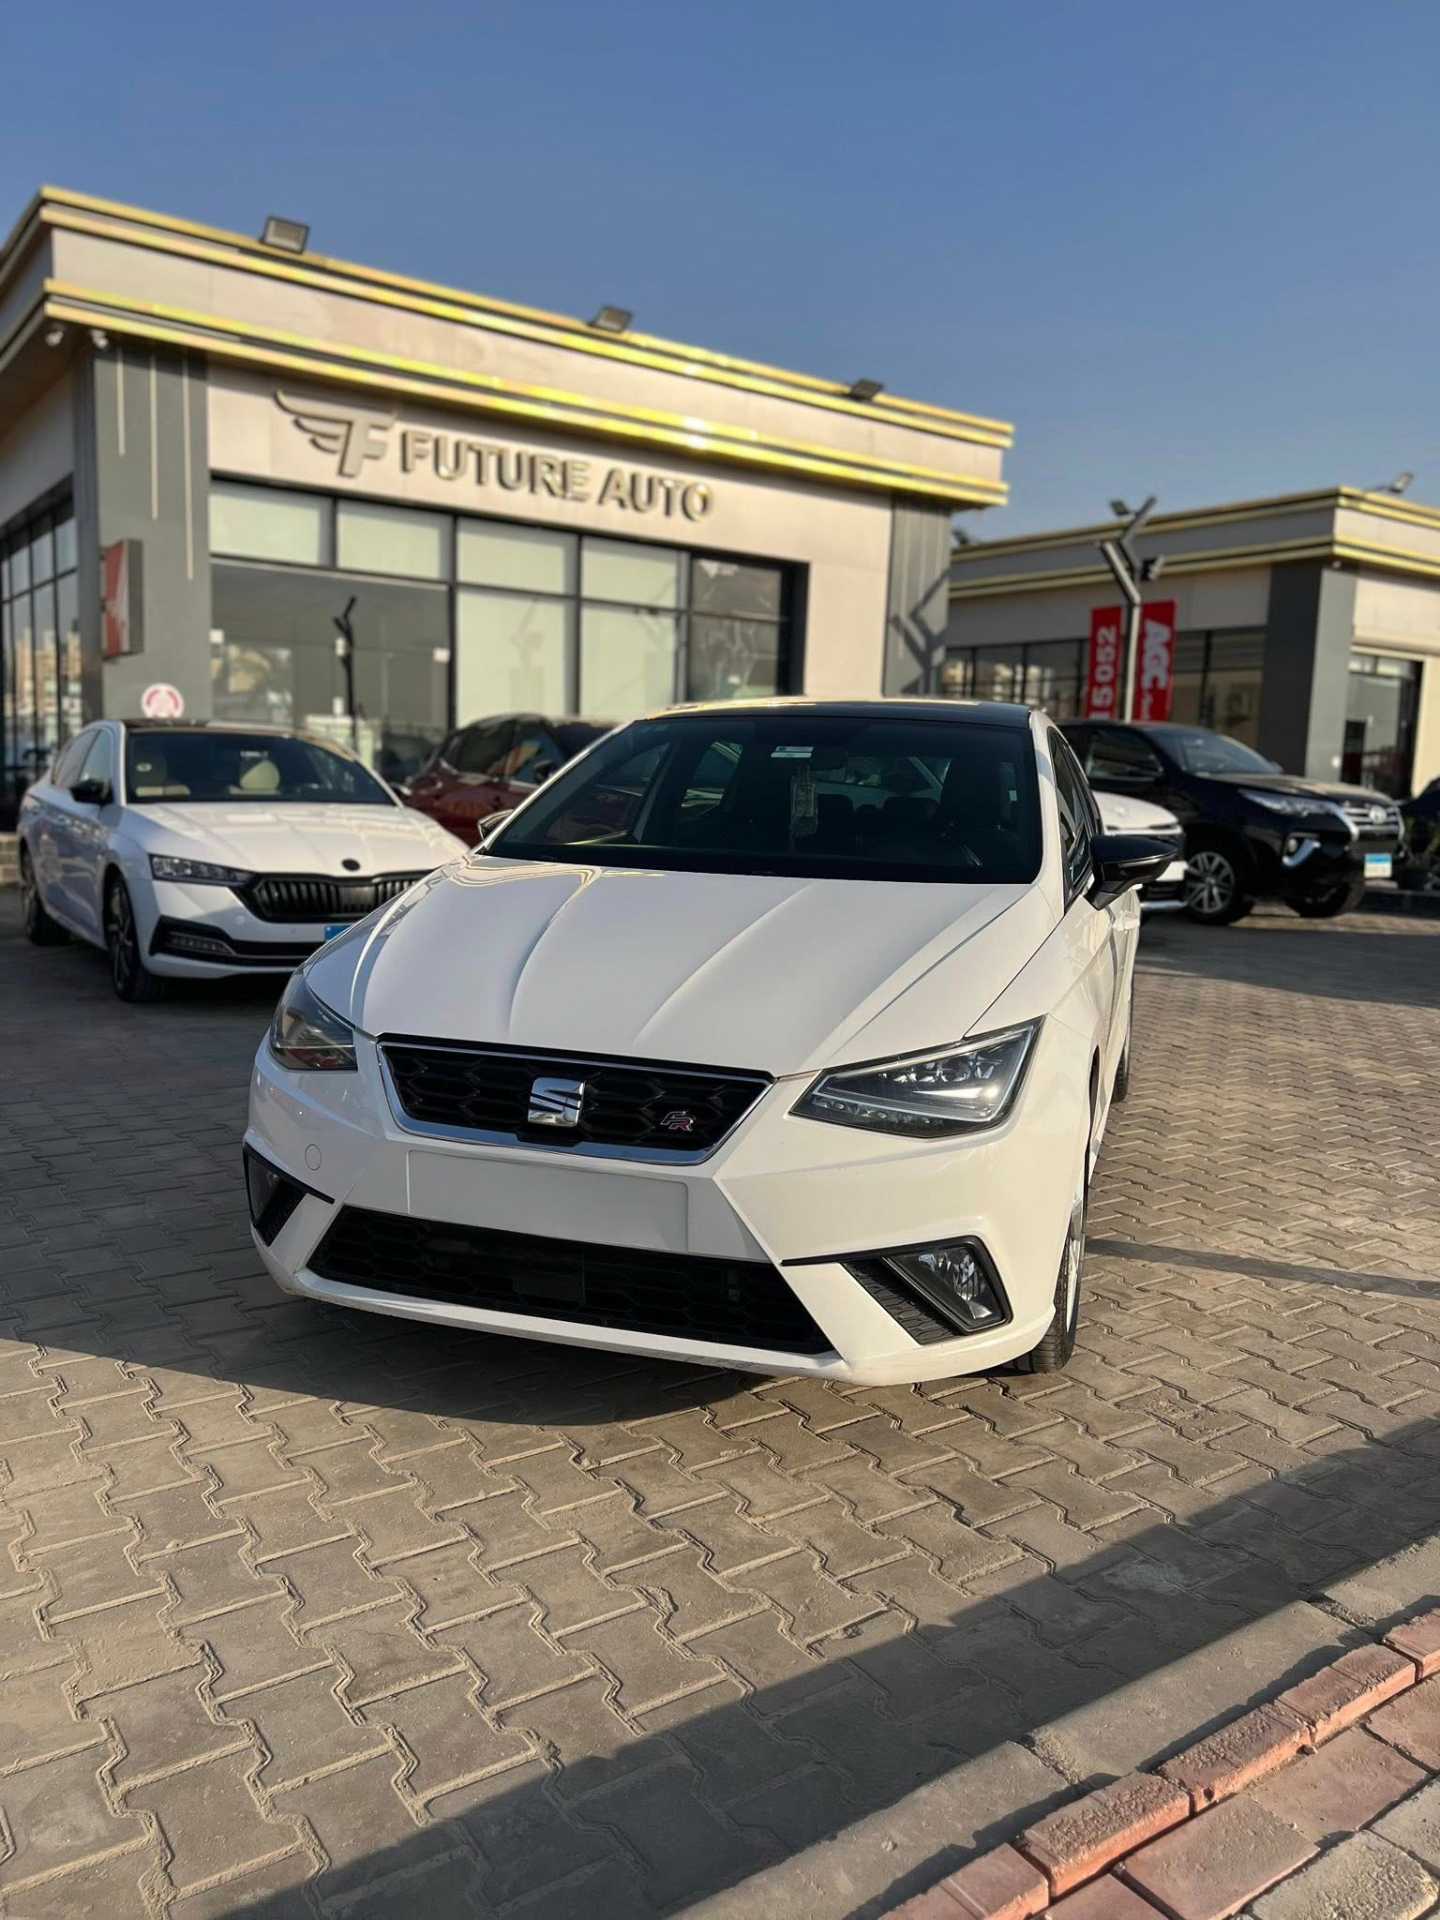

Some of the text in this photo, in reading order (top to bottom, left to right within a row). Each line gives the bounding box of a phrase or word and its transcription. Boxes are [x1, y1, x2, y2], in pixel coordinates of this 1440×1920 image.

[400, 429, 715, 522] FUTURE AUTO
[1088, 624, 1118, 720] 15052
[660, 1110, 696, 1132] FR
